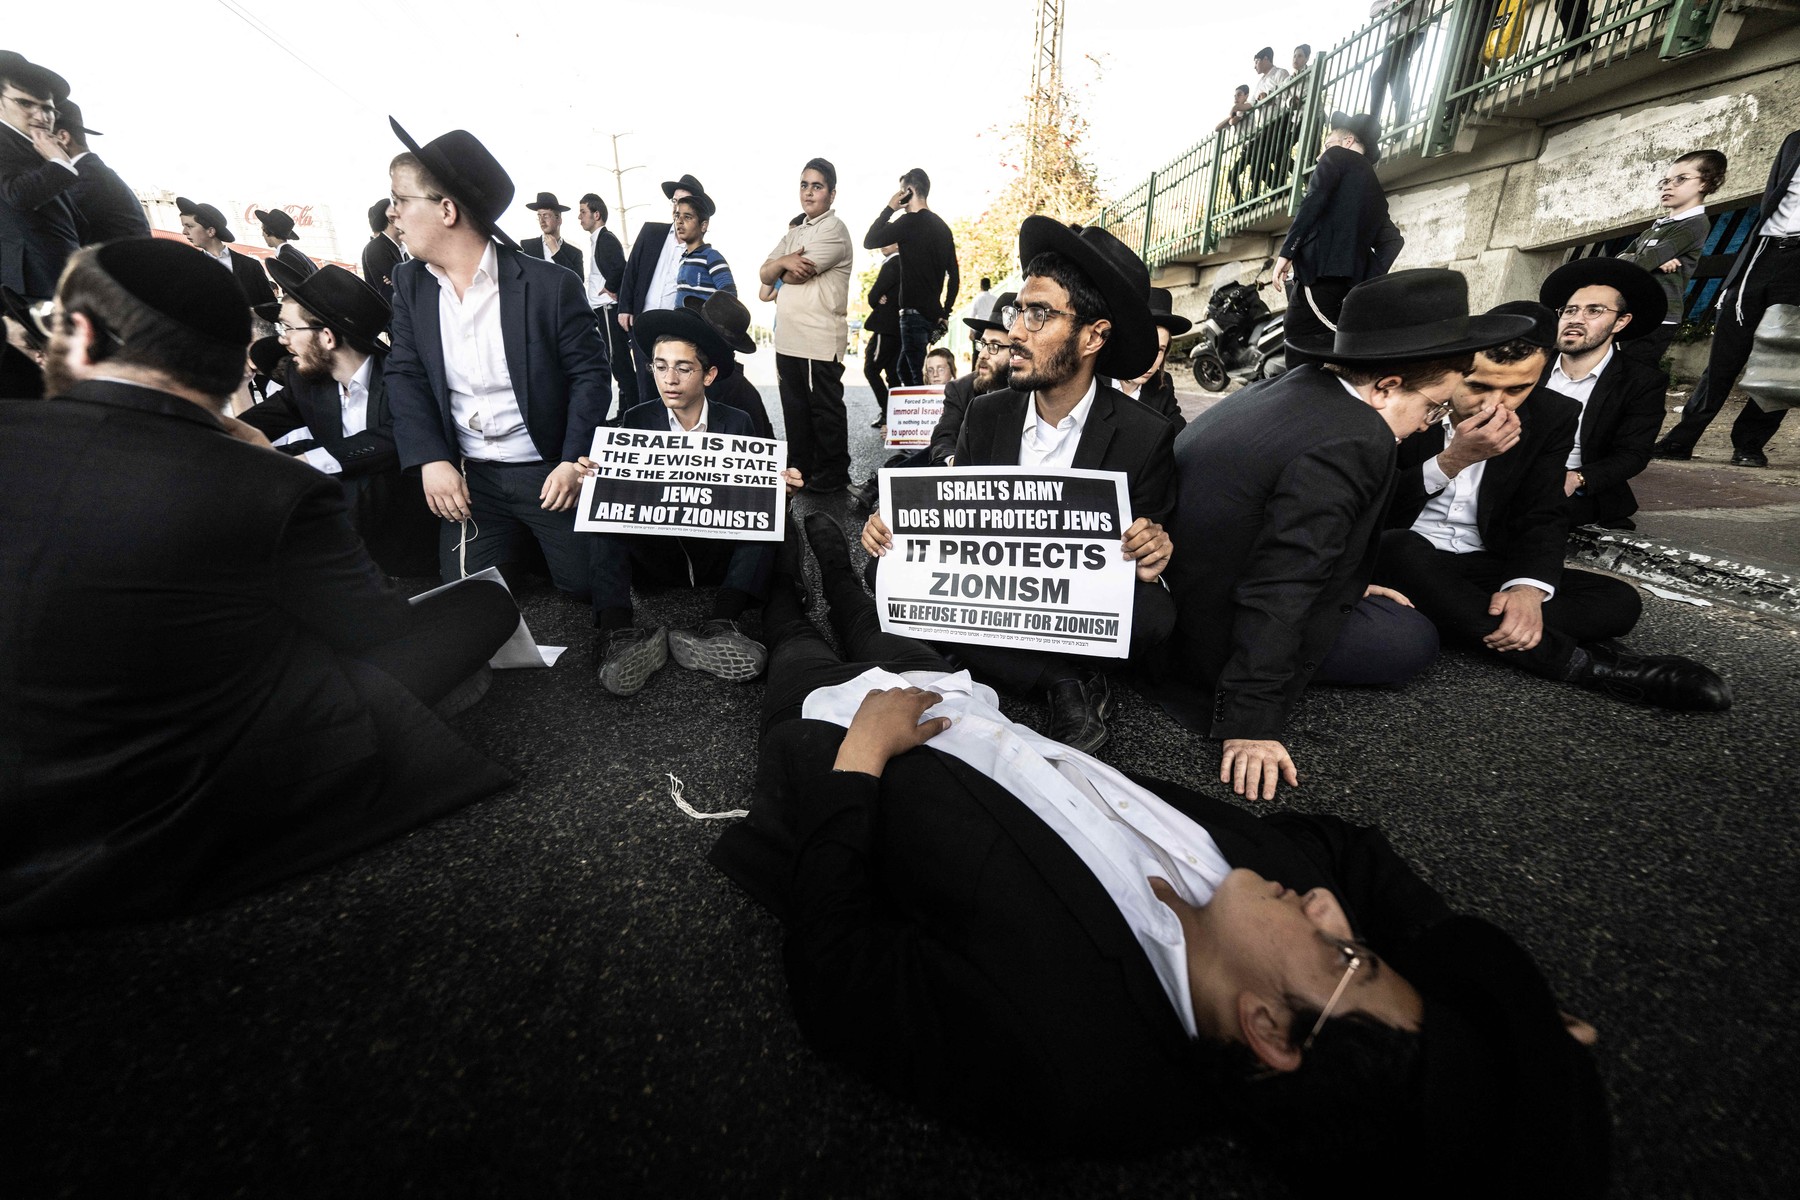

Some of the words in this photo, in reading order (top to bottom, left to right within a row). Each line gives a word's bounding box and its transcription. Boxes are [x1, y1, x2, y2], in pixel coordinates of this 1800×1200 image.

[606, 432, 694, 450] ISRAEL
[701, 436, 724, 451] IS
[731, 440, 778, 456] NOT
[602, 450, 640, 464] THE
[644, 453, 716, 468] JEWISH
[722, 457, 778, 473] STATE
[597, 466, 612, 476] IT
[615, 468, 632, 478] IS
[636, 469, 665, 480] THE
[668, 470, 730, 484] ZIONIST
[734, 474, 778, 486] STATE
[660, 486, 713, 505] JEWS
[936, 480, 1010, 502] ISRAEL'S
[1013, 480, 1064, 502] ARMY
[594, 502, 636, 521] ARE
[638, 505, 680, 524] NOT
[681, 507, 770, 530] ZIONISTS
[898, 508, 940, 529] DOES
[943, 508, 977, 528] NOT
[980, 509, 1060, 530] PROTECT
[1062, 510, 1113, 532] JEWS
[905, 539, 930, 562] IT
[939, 540, 1106, 570] PROTECTS
[929, 572, 1070, 605] ZIONISM
[888, 602, 907, 619] WE
[909, 604, 957, 622] REFUSE
[960, 608, 978, 625] TO
[980, 610, 1022, 628] FIGHT
[1024, 613, 1052, 631] FOR
[1054, 616, 1120, 636] ZIONISM
